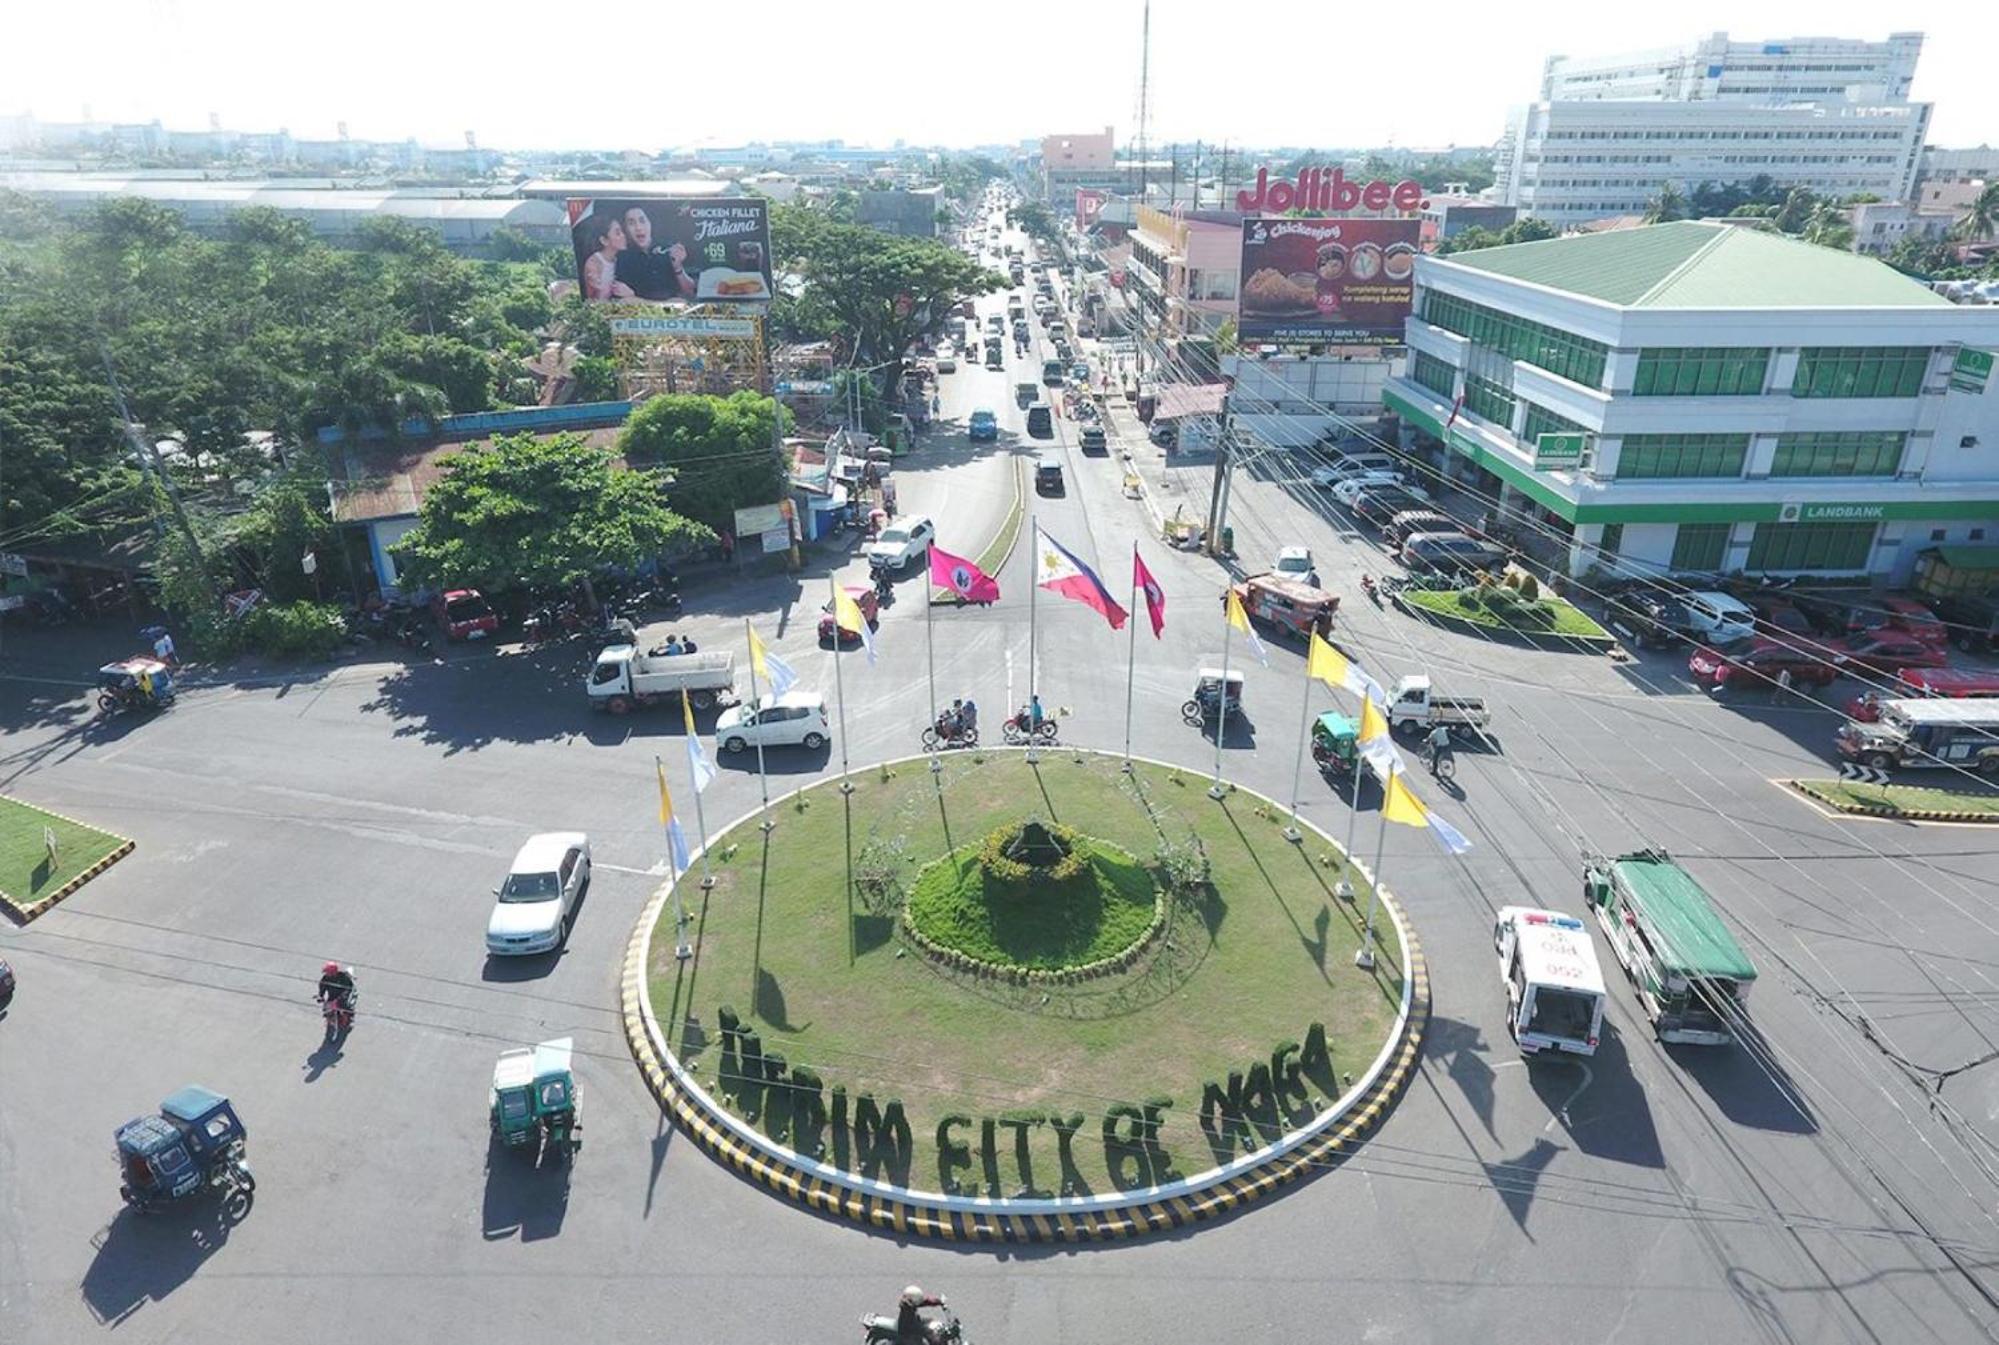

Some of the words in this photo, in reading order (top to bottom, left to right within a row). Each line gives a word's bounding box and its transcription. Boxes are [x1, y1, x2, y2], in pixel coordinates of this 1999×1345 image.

[690, 207, 730, 218] CHICKEN
[731, 207, 761, 217] FILLET
[694, 218, 760, 241] Italiana
[1270, 221, 1341, 241] Chickenjoy
[627, 319, 717, 330] EUROTEL
[1807, 507, 1884, 518] LANDBANK
